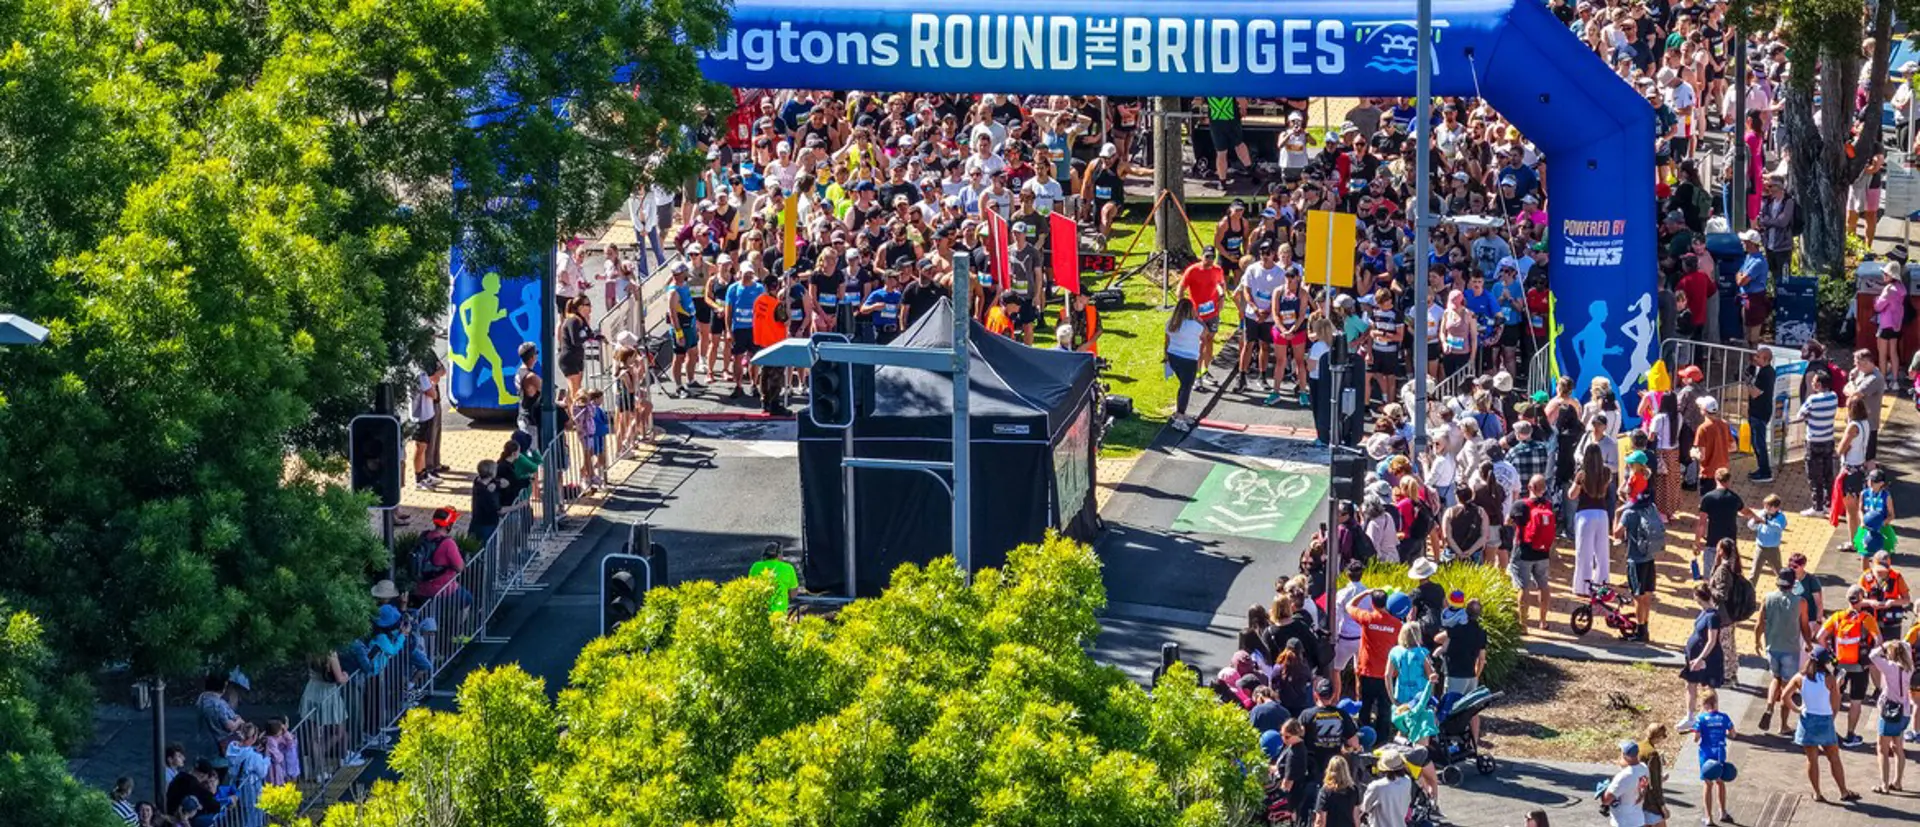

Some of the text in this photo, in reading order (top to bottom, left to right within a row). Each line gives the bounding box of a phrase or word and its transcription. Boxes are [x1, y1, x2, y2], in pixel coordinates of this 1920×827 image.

[694, 12, 1345, 75] ugtons ROUND THE BRIDGES
[1563, 219, 1626, 237] POWERED BY
